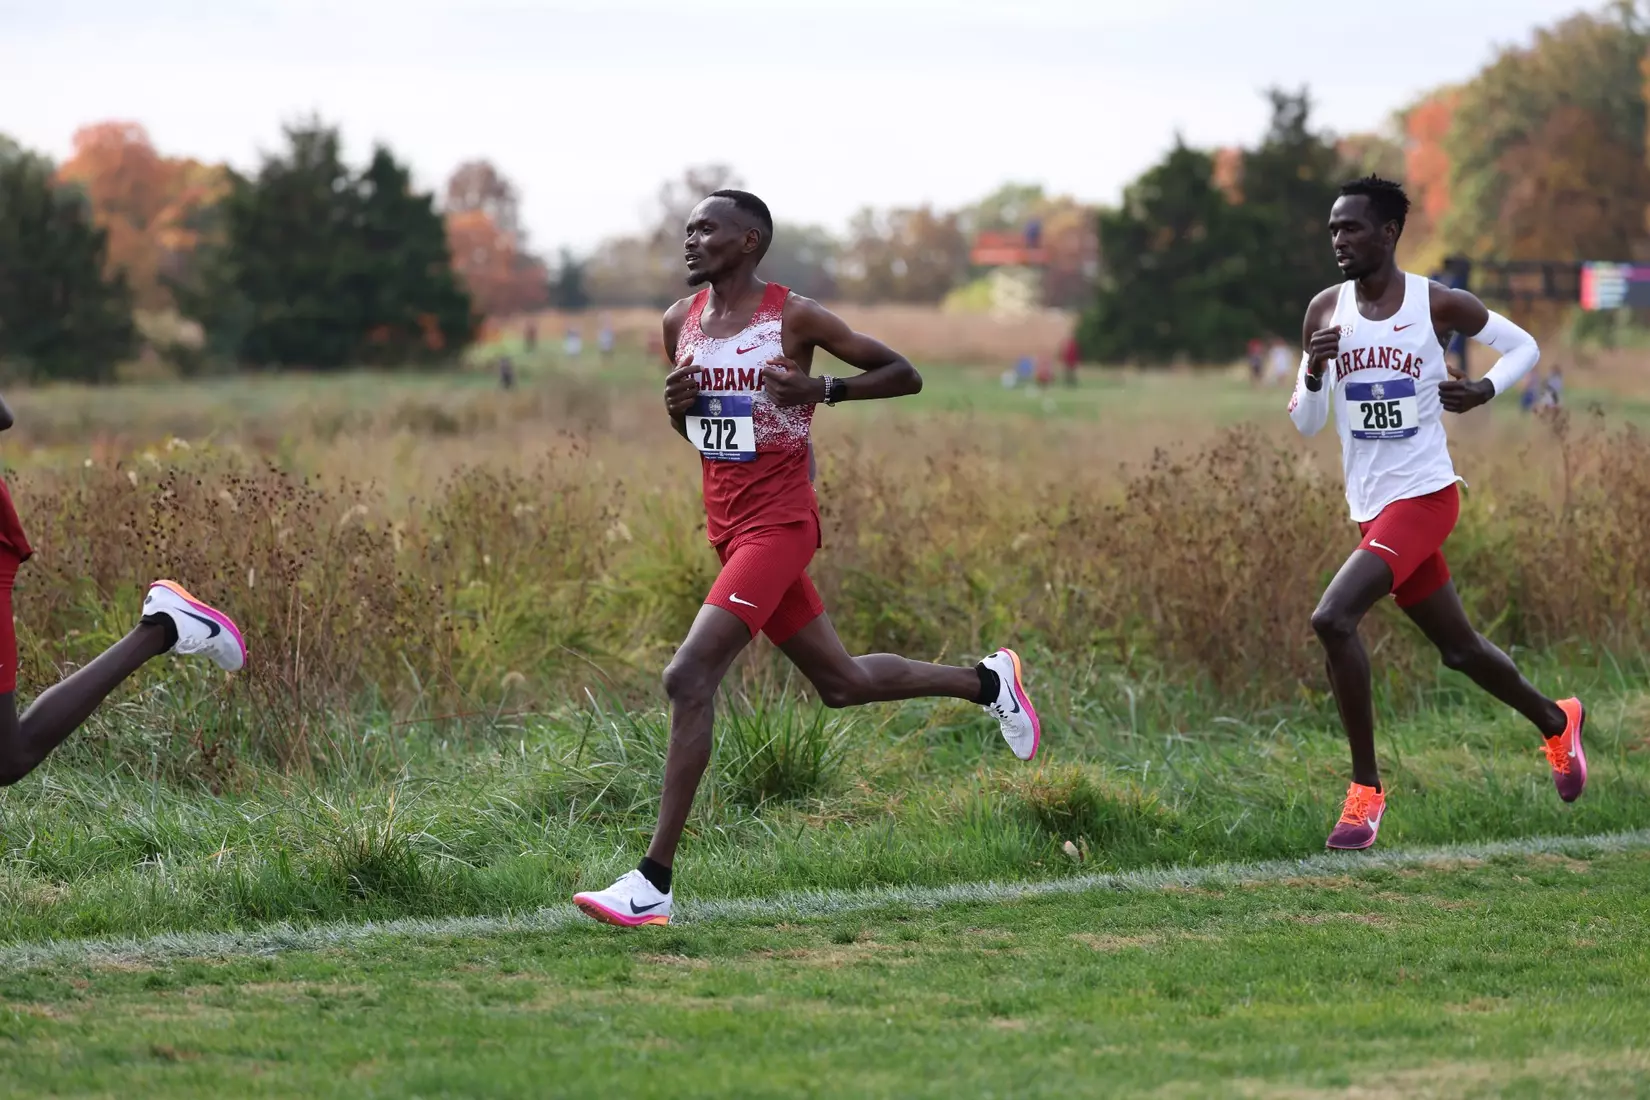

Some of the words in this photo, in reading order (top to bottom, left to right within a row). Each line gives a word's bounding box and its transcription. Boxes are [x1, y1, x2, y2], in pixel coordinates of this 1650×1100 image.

[1335, 346, 1423, 382] ARKANSAS
[1360, 400, 1403, 429] 285
[700, 418, 738, 450] 272
